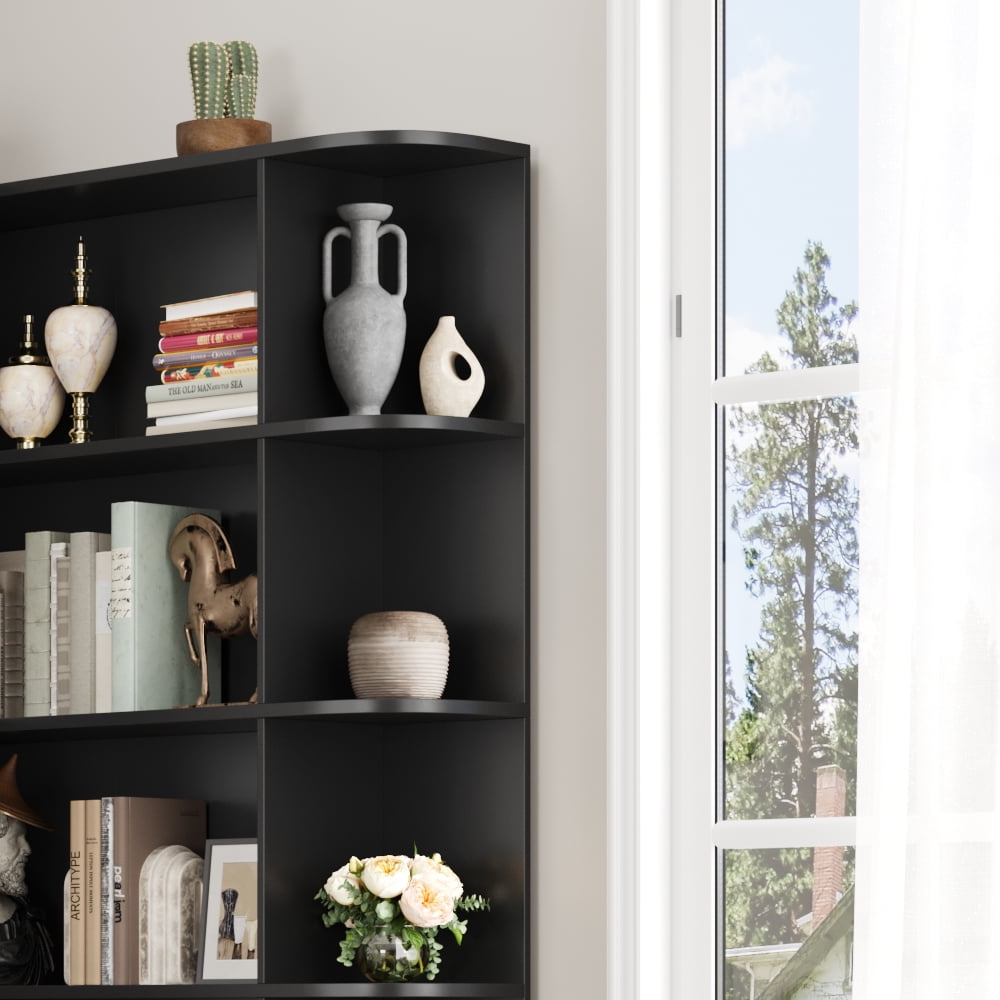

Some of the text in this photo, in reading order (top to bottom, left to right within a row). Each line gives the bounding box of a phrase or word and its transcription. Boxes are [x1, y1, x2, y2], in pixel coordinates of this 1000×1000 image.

[168, 387, 182, 396] THE
[182, 385, 196, 394] OLD
[197, 384, 212, 392] MAN
[230, 380, 244, 389] SEA
[70, 851, 81, 921] ARCHITYPE
[114, 866, 126, 898] pearl
